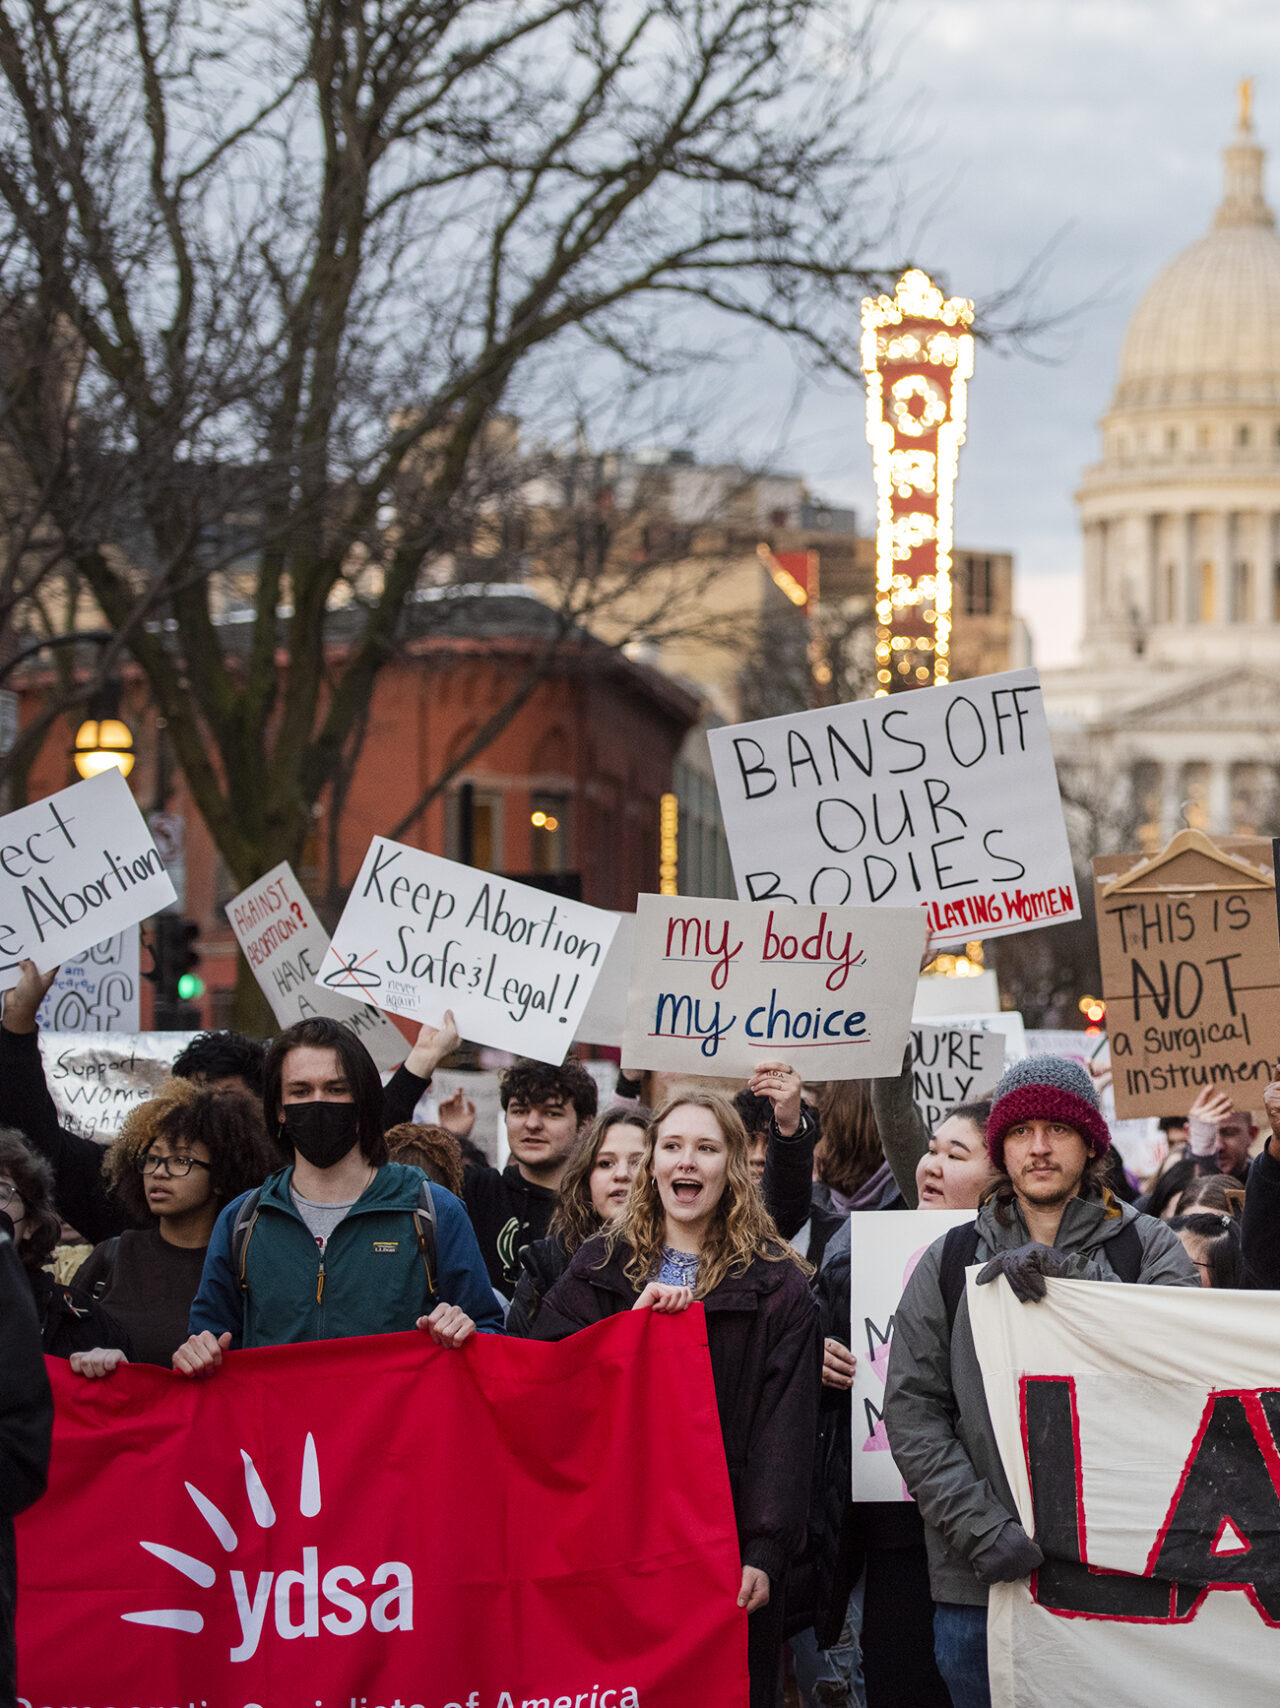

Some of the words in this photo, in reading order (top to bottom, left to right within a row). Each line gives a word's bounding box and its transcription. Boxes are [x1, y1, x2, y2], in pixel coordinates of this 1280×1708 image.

[733, 710, 927, 799] BANS
[944, 685, 1041, 768] OFF
[0, 801, 76, 878] ect
[815, 778, 968, 853] OUR
[21, 847, 166, 944] Abortion
[233, 876, 291, 937] AGAINST
[362, 844, 456, 933] Keep
[465, 882, 602, 967] Abortion
[921, 893, 1003, 933] LATING
[1000, 885, 1075, 922] WOMEN
[1106, 900, 1196, 954] THIS
[1212, 895, 1252, 931] IS
[248, 901, 309, 970] ABORTION?
[386, 924, 466, 990] Safe
[664, 915, 744, 990] my
[272, 947, 320, 998] HAVE
[386, 977, 419, 995] never
[1130, 953, 1243, 1024] NOT
[297, 994, 318, 1018] A
[53, 1048, 145, 1080] Support
[1113, 1032, 1133, 1056] a
[63, 1085, 151, 1105] Wome
[913, 1070, 974, 1102] NLY
[62, 1108, 123, 1141] Right
[229, 1544, 414, 1663] ydsa
